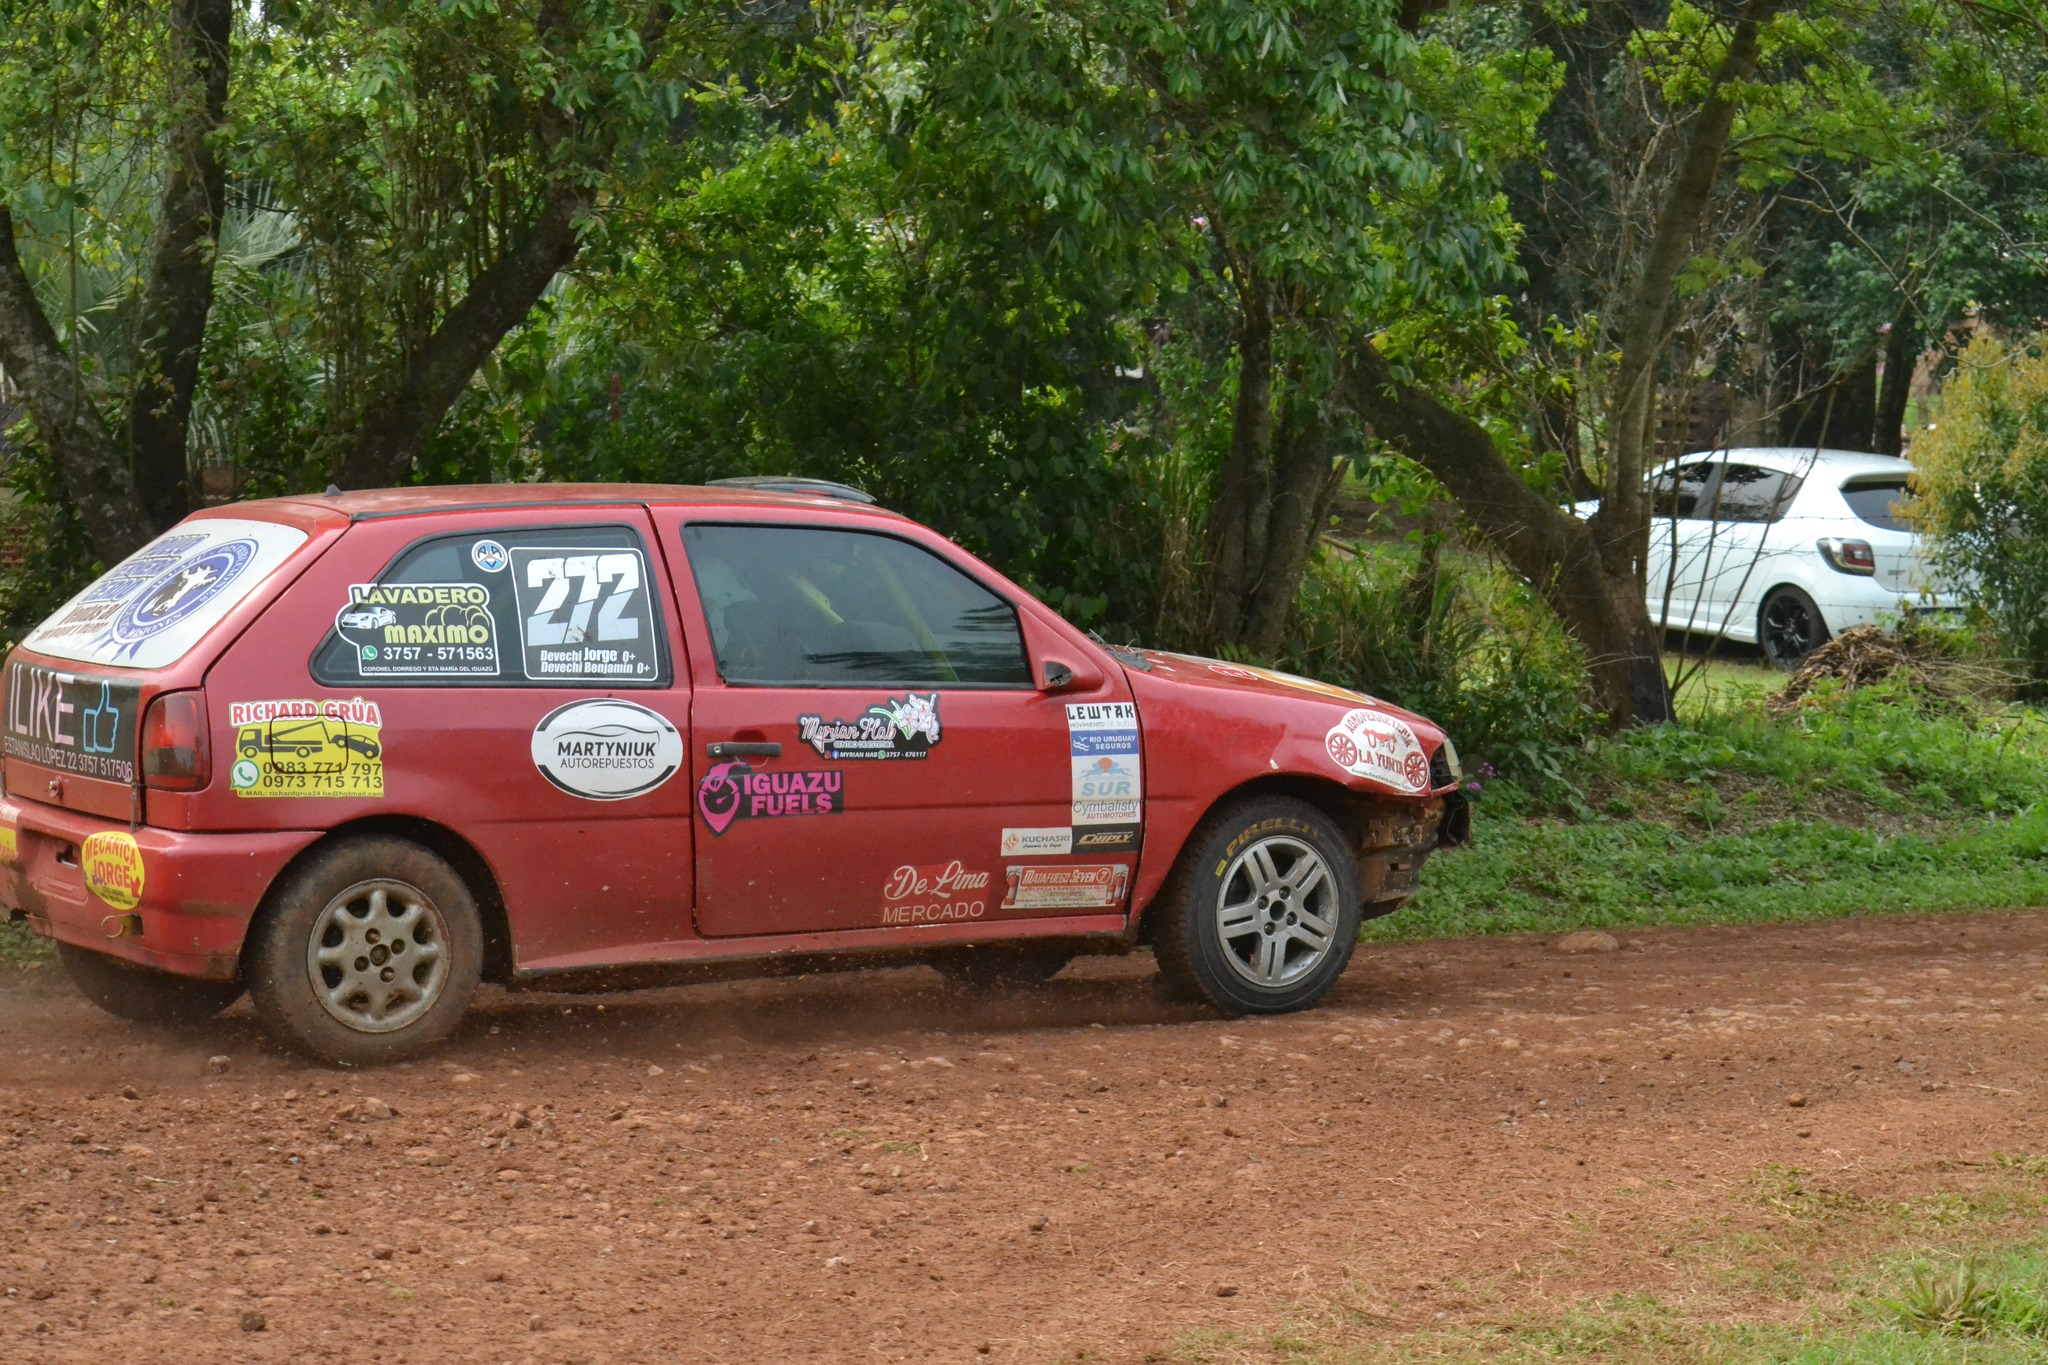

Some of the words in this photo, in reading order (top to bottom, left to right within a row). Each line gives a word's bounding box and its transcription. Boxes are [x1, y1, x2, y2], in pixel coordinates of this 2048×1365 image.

[353, 588, 485, 604] LAVADERO
[527, 553, 640, 647] 272
[384, 625, 489, 644] MAXIMO
[383, 647, 421, 660] 3757
[437, 647, 494, 660] 571563
[541, 650, 582, 662] Devechi
[584, 647, 618, 662] Jorge
[541, 661, 582, 673] Devechi
[232, 701, 318, 724] RICHARD
[324, 698, 380, 725] GRÚA
[1067, 705, 1134, 720] LEWTAK
[800, 716, 859, 754] Myrian
[860, 718, 896, 740] Hab
[1103, 735, 1136, 743] URUGUAY
[557, 741, 657, 756] MARTYNIUK
[1095, 742, 1132, 750] SEGUROS
[4, 736, 40, 761] ESTANISLAO
[41, 743, 66, 768] LÓPEZ
[66, 751, 78, 770] 22
[79, 753, 98, 773] 3757
[100, 758, 133, 779] 517506
[560, 758, 655, 769] AUTOREPUESTOS
[1358, 748, 1374, 765] LA
[1375, 752, 1405, 776] YUNTA
[263, 762, 307, 775] 0983
[313, 762, 343, 775] 771
[351, 763, 382, 776] 797
[263, 776, 306, 788] 0973
[313, 776, 345, 788] 715
[352, 776, 383, 789] 713
[744, 772, 841, 794] IGUAZU
[1081, 781, 1132, 797] SUR
[751, 794, 833, 816] FUELS
[1073, 800, 1139, 815] Cymbalisty
[1086, 811, 1137, 819] AUTOMOTORES
[1022, 835, 1070, 843] KUCHASKI
[1078, 834, 1134, 844] CHIPLY
[91, 858, 131, 889] JORGE
[884, 865, 928, 900] De
[927, 860, 989, 898] Lima
[1100, 871, 1108, 882] 7
[883, 900, 985, 923] MERCADO
